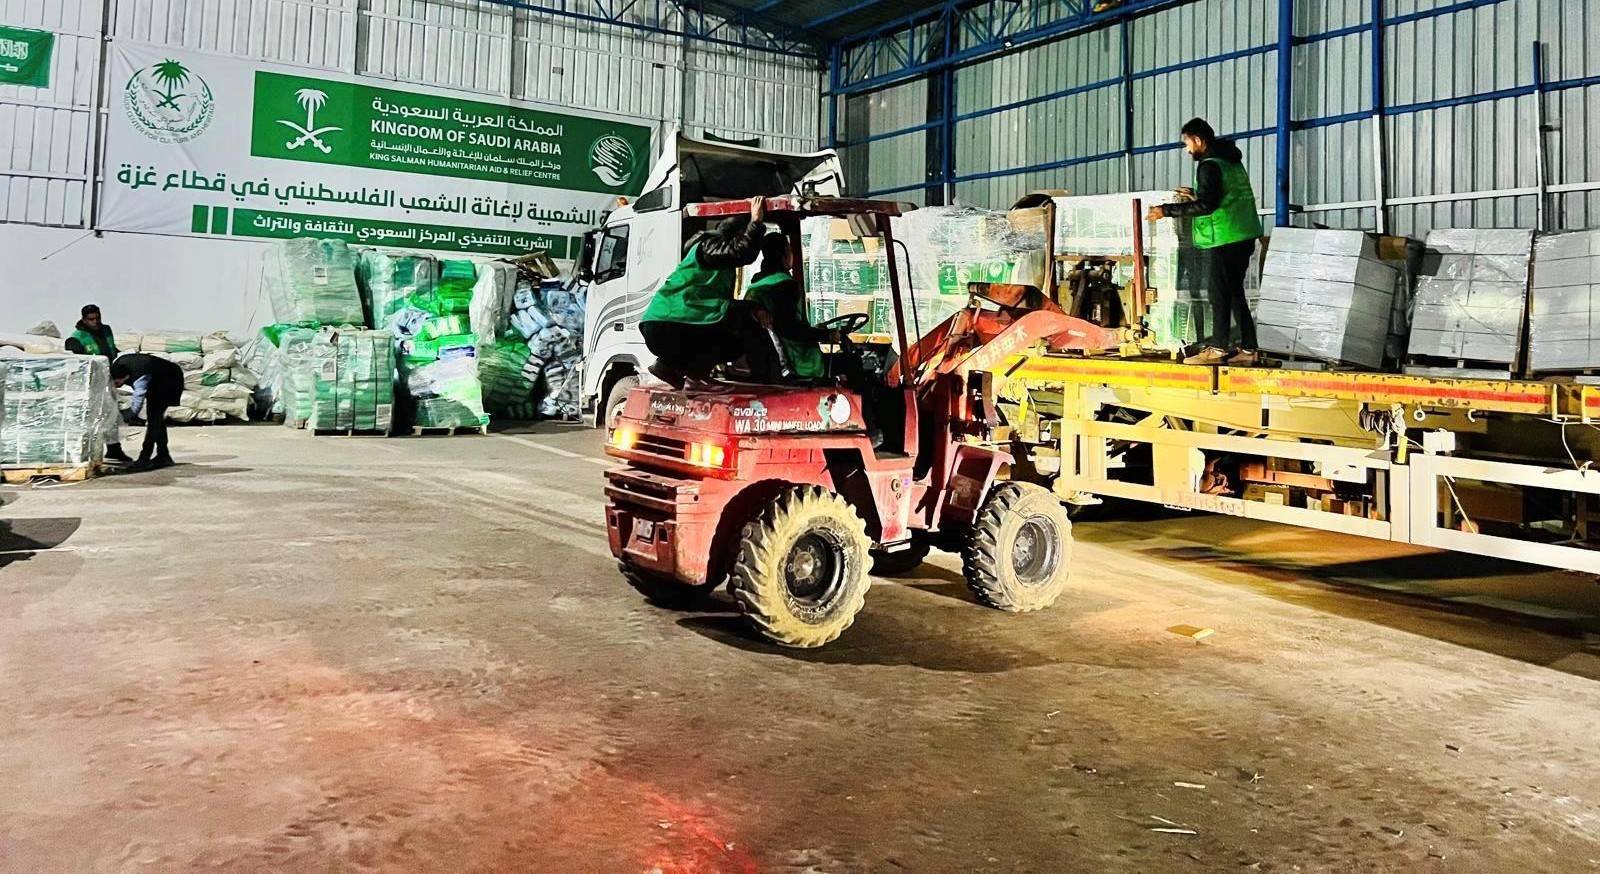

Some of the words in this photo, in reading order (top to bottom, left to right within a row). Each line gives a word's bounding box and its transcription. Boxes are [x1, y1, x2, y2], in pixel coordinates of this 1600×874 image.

[372, 96, 449, 121] السعودية
[452, 107, 504, 128] العربية
[507, 115, 563, 137] المملكة
[371, 119, 443, 141] KINGDOM
[446, 130, 466, 143] OF
[468, 132, 511, 149] SAUDI
[513, 138, 562, 155] ARABIA
[369, 152, 390, 162] KING
[391, 155, 426, 166] SALMAN
[427, 159, 488, 173] HUMANITARIAN
[488, 166, 503, 175] AID
[503, 167, 509, 175] &
[509, 168, 533, 178] RELIEF
[533, 171, 562, 181] CENTRE
[483, 153, 516, 164] سلمان
[516, 157, 540, 168] الملك
[540, 160, 562, 171] مركز
[117, 163, 157, 190] غزة
[162, 169, 227, 192] قطاع
[230, 177, 270, 202] في
[274, 181, 395, 207] الفلسطيني
[399, 193, 467, 214] الشعب
[471, 196, 524, 223] لإغاثة
[253, 214, 302, 234] والتراث
[527, 203, 596, 226] الشعبية
[304, 219, 354, 235] للثقافة
[356, 226, 417, 242] السعودي
[418, 228, 456, 244] المركز
[458, 232, 511, 249] التنفيذي
[513, 236, 553, 251] الشريك
[735, 419, 751, 433] WA
[754, 418, 766, 432] 30
